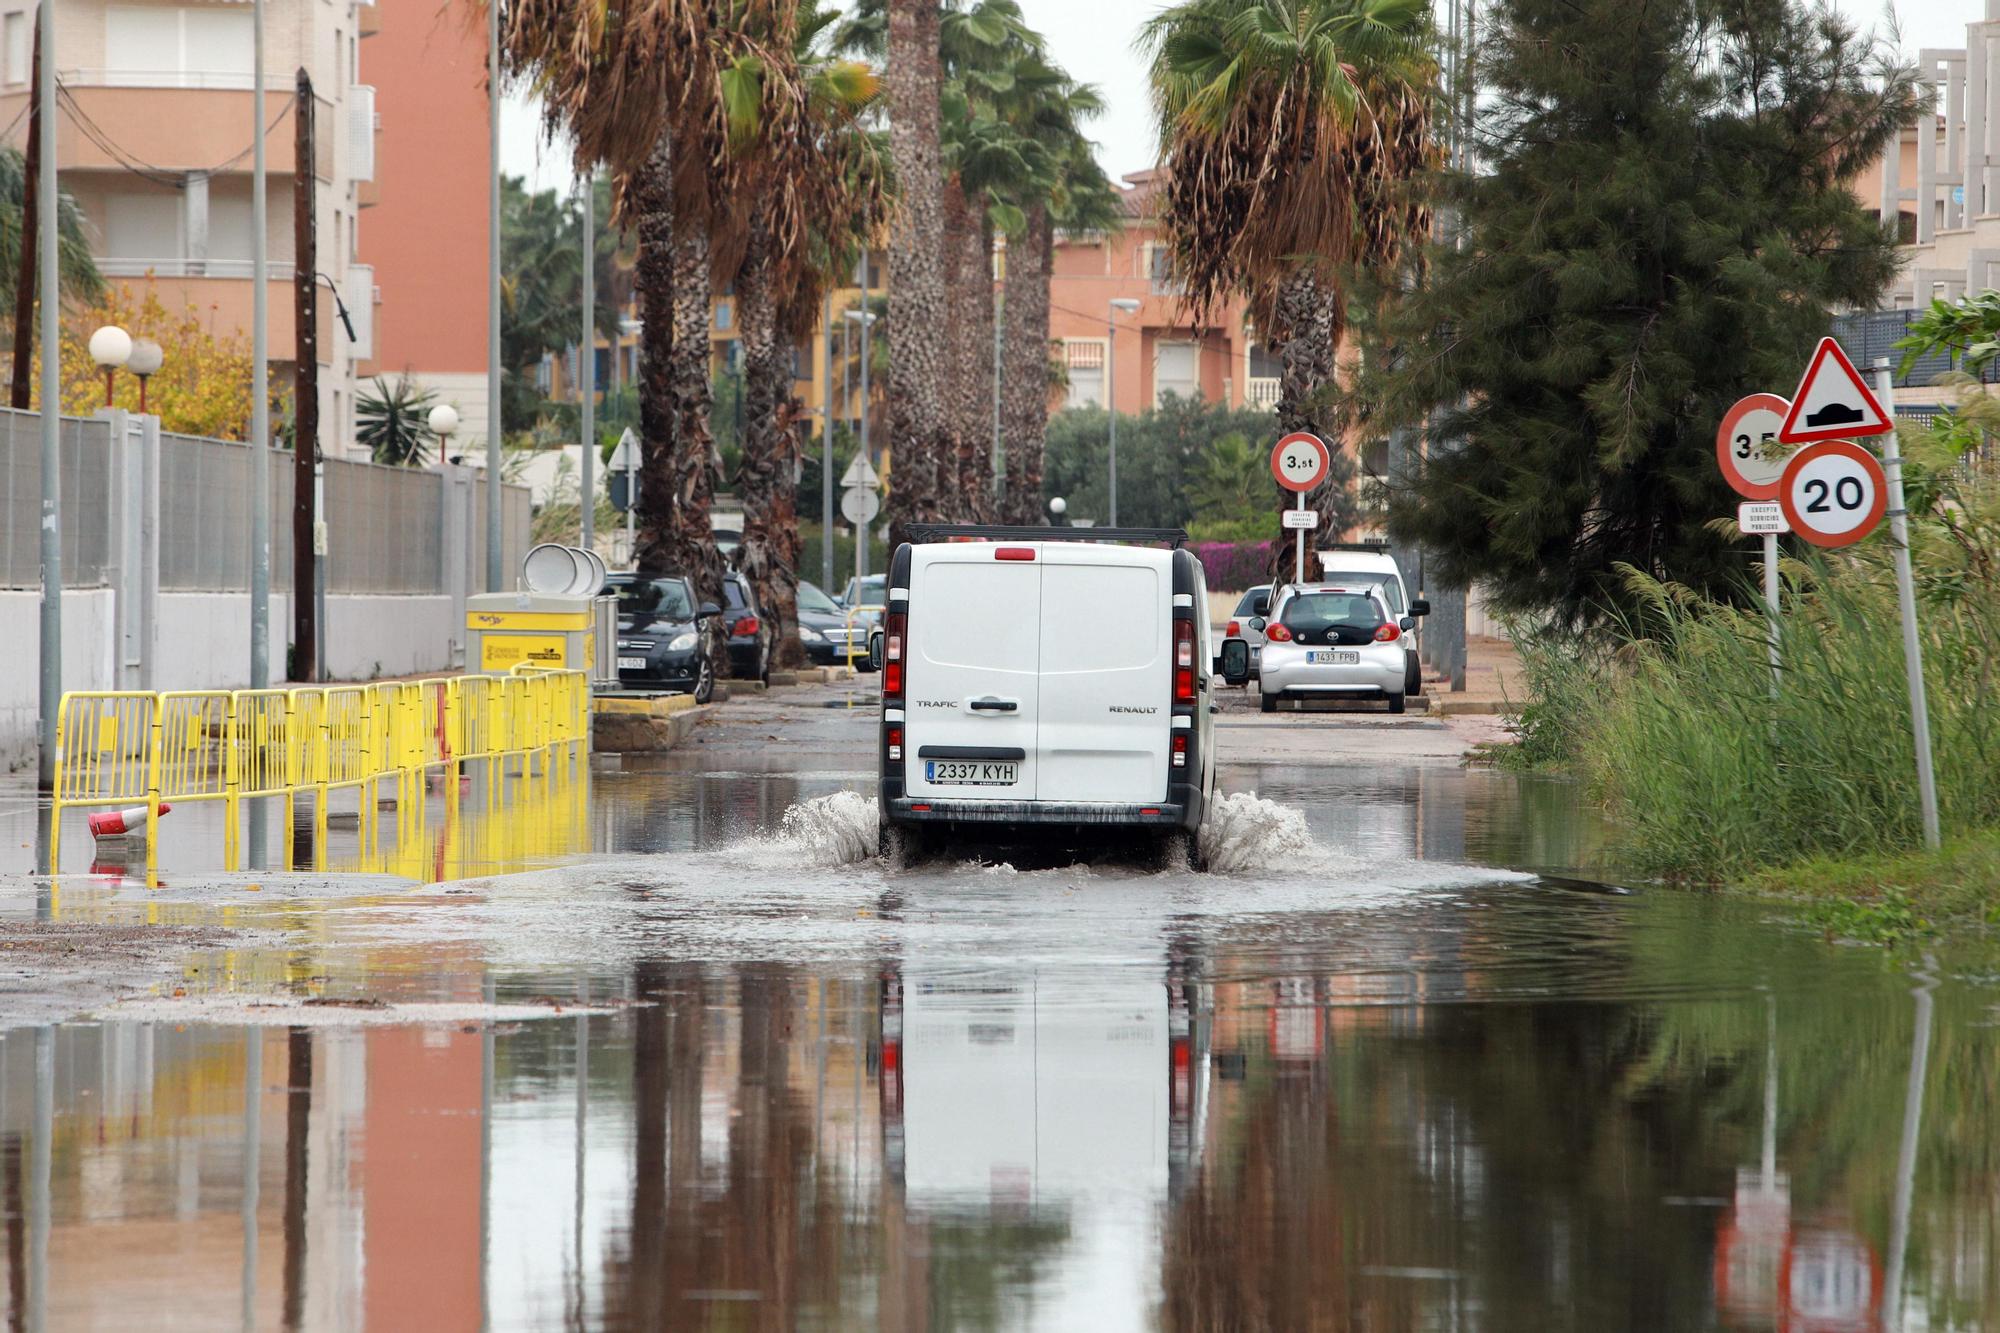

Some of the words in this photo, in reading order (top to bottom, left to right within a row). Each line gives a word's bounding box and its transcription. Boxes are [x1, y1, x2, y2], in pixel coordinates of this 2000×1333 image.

[1804, 476, 1864, 513] 20
[916, 700, 958, 708] TRAFIC
[1109, 705, 1158, 714] RENAULT
[937, 764, 978, 779] 2337
[983, 764, 1013, 780] KYH
